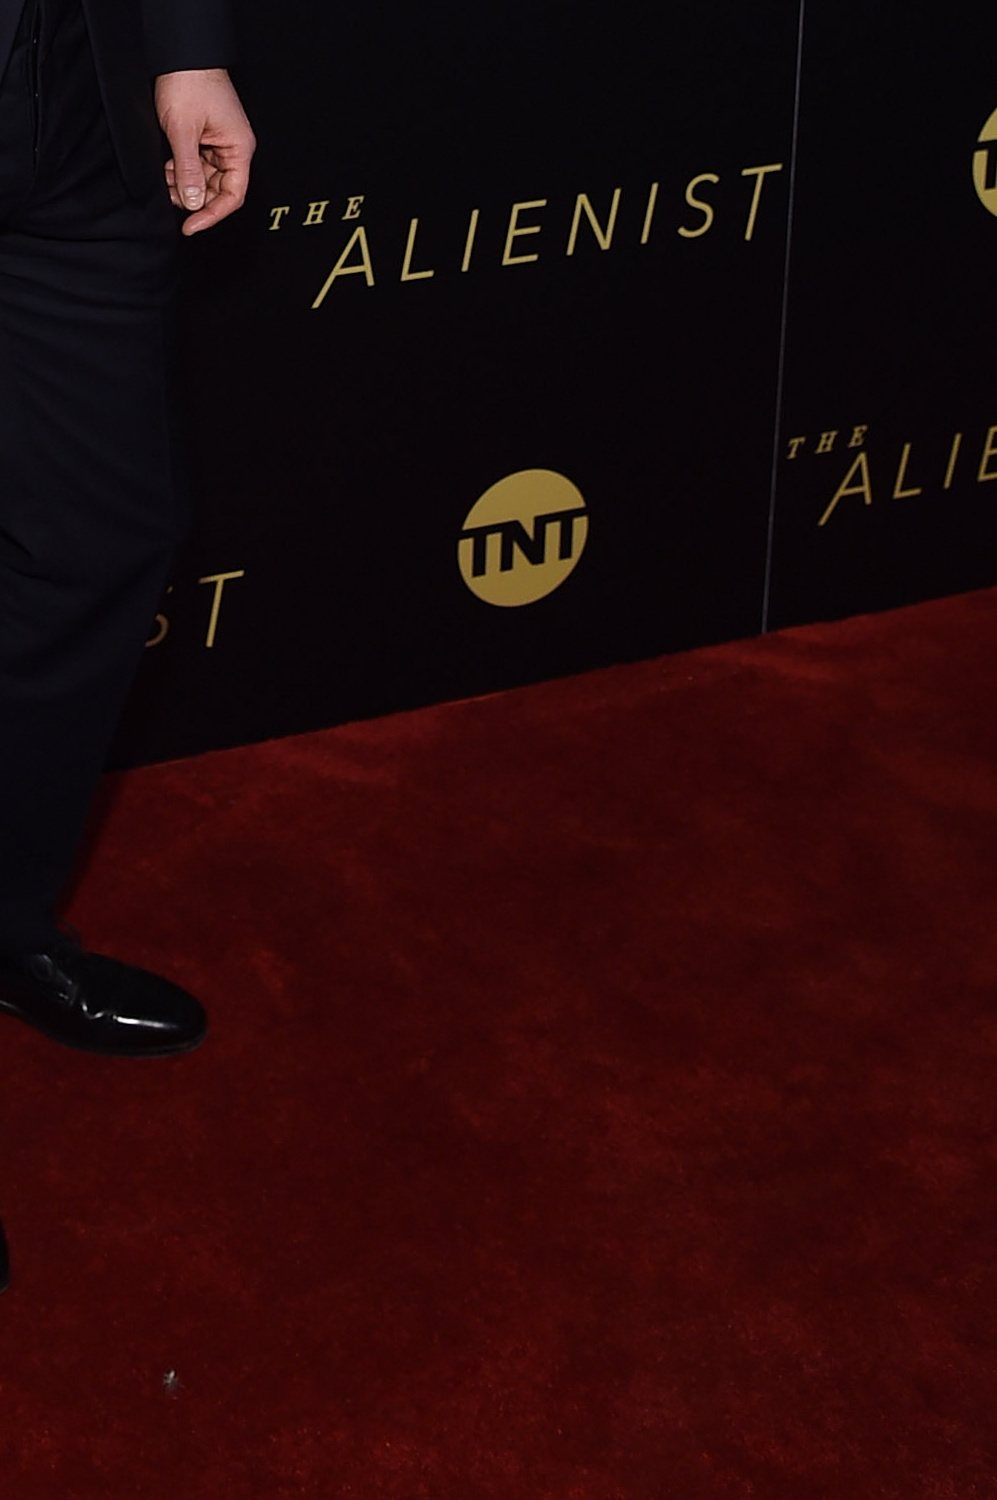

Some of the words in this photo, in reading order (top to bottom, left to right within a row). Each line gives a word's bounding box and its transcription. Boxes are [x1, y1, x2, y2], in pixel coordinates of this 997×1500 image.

[269, 196, 365, 231] THE
[312, 164, 783, 309] ALIENIST
[788, 425, 868, 459] THE
[459, 506, 588, 579] TNT
